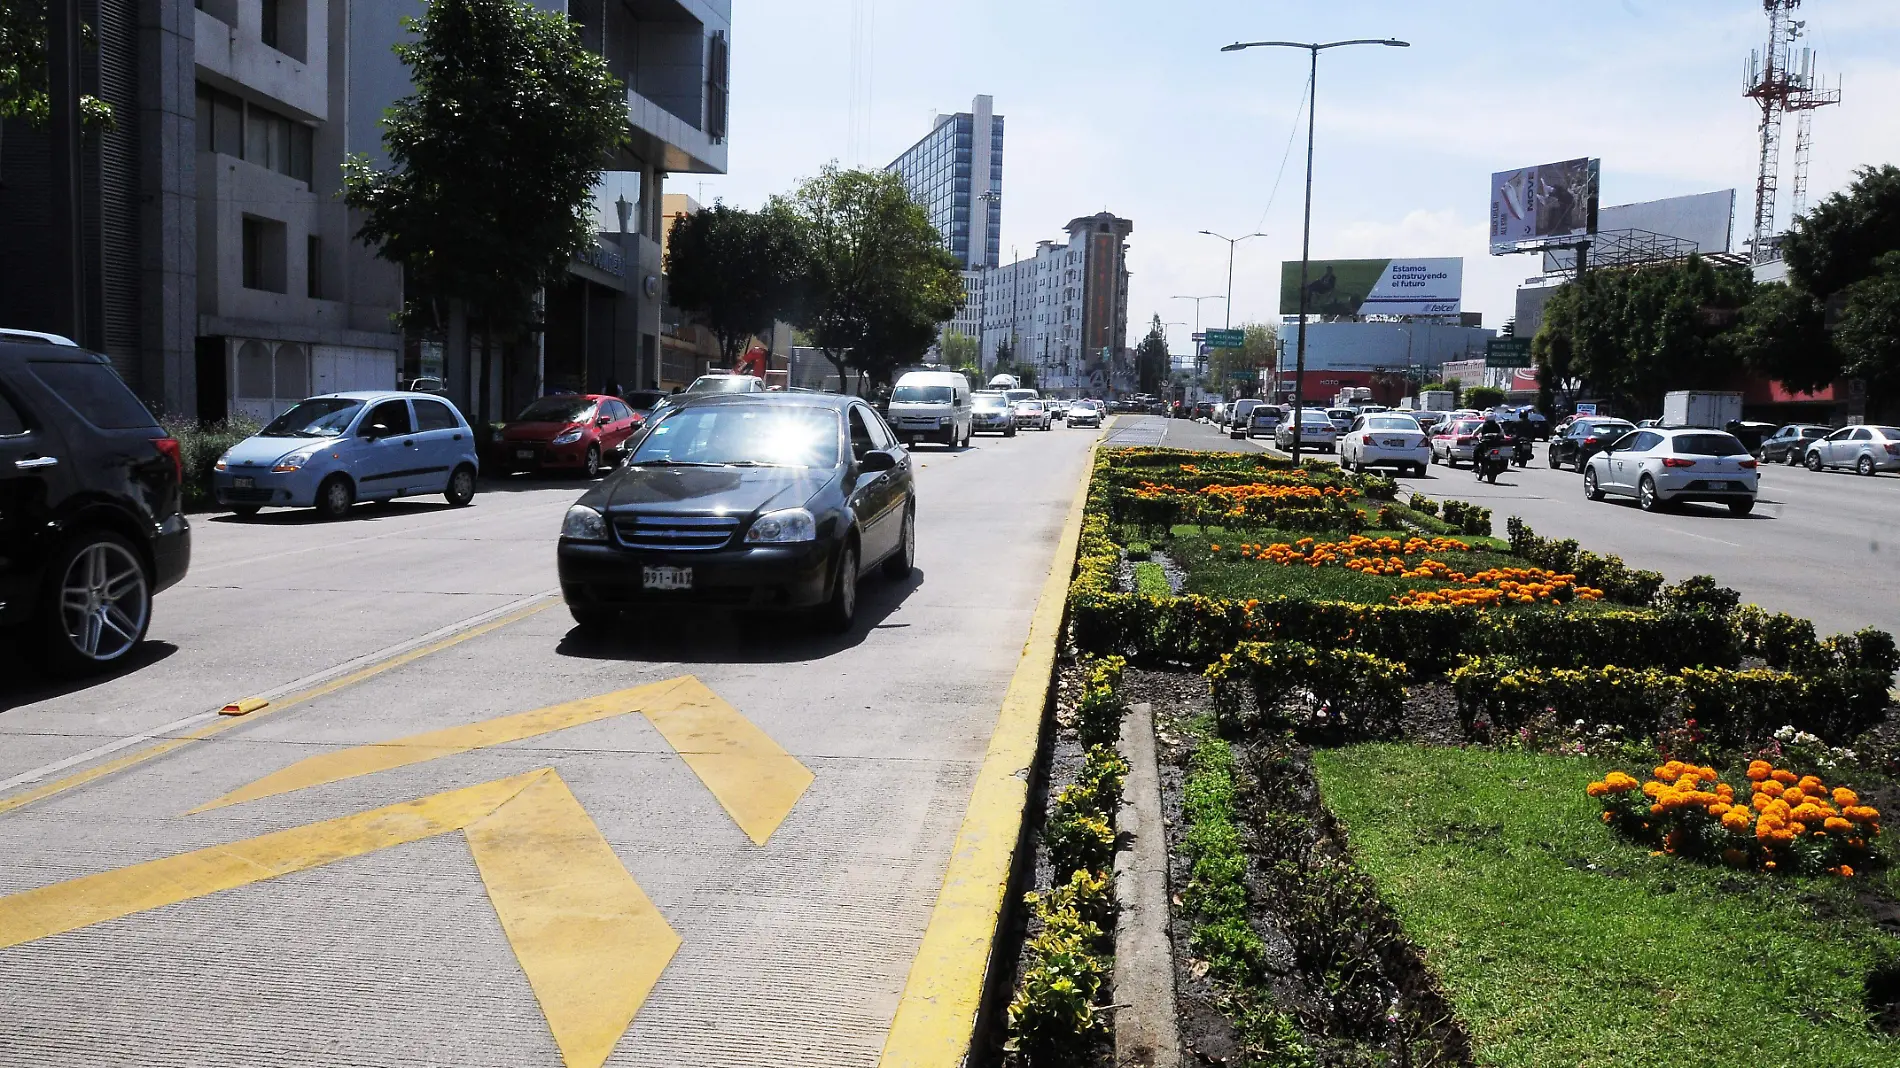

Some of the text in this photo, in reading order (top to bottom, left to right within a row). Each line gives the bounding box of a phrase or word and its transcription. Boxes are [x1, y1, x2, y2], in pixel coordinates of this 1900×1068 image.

[1392, 272, 1448, 281] construyendo
[1400, 280, 1426, 288] futuro
[1430, 303, 1456, 312] telcel
